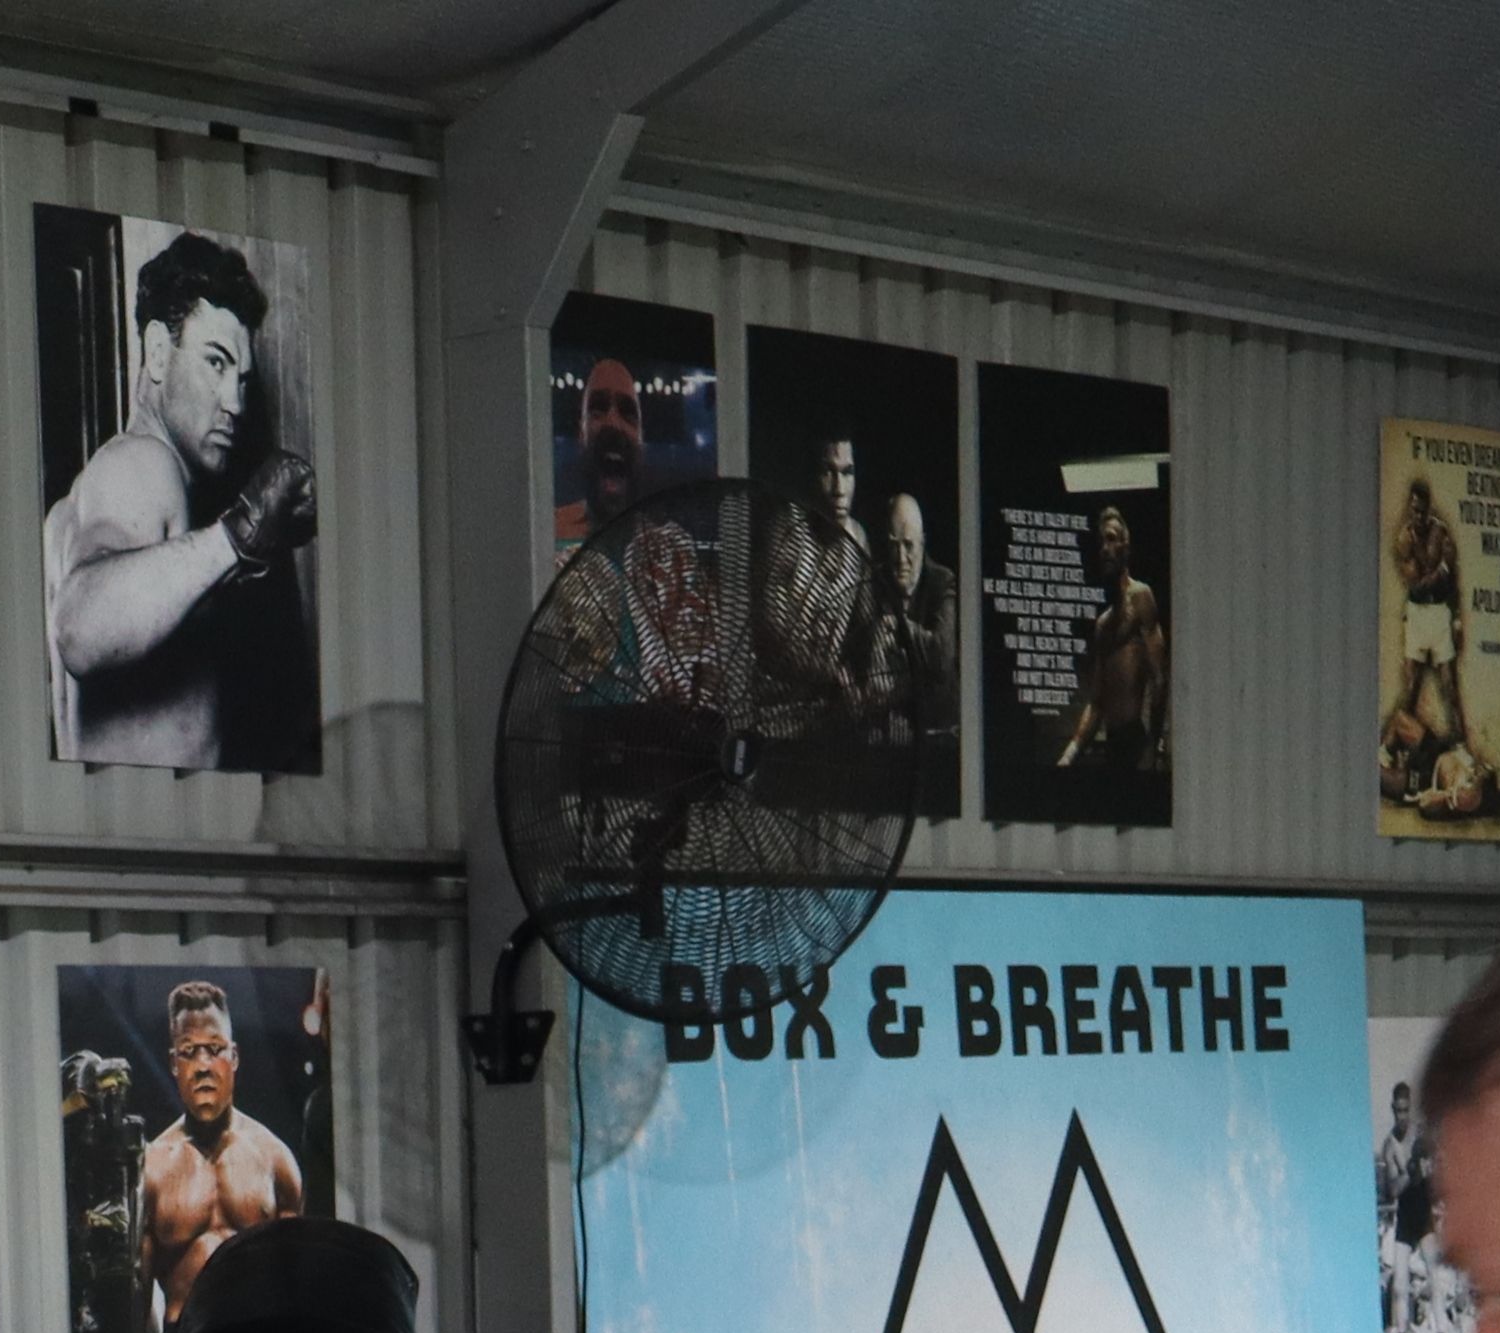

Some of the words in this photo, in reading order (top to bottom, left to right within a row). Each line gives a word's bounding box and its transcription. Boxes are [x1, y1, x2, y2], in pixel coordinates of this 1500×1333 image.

[660, 963, 837, 1063] BOX
[867, 964, 926, 1059] &
[952, 963, 1291, 1058] BREATHE
